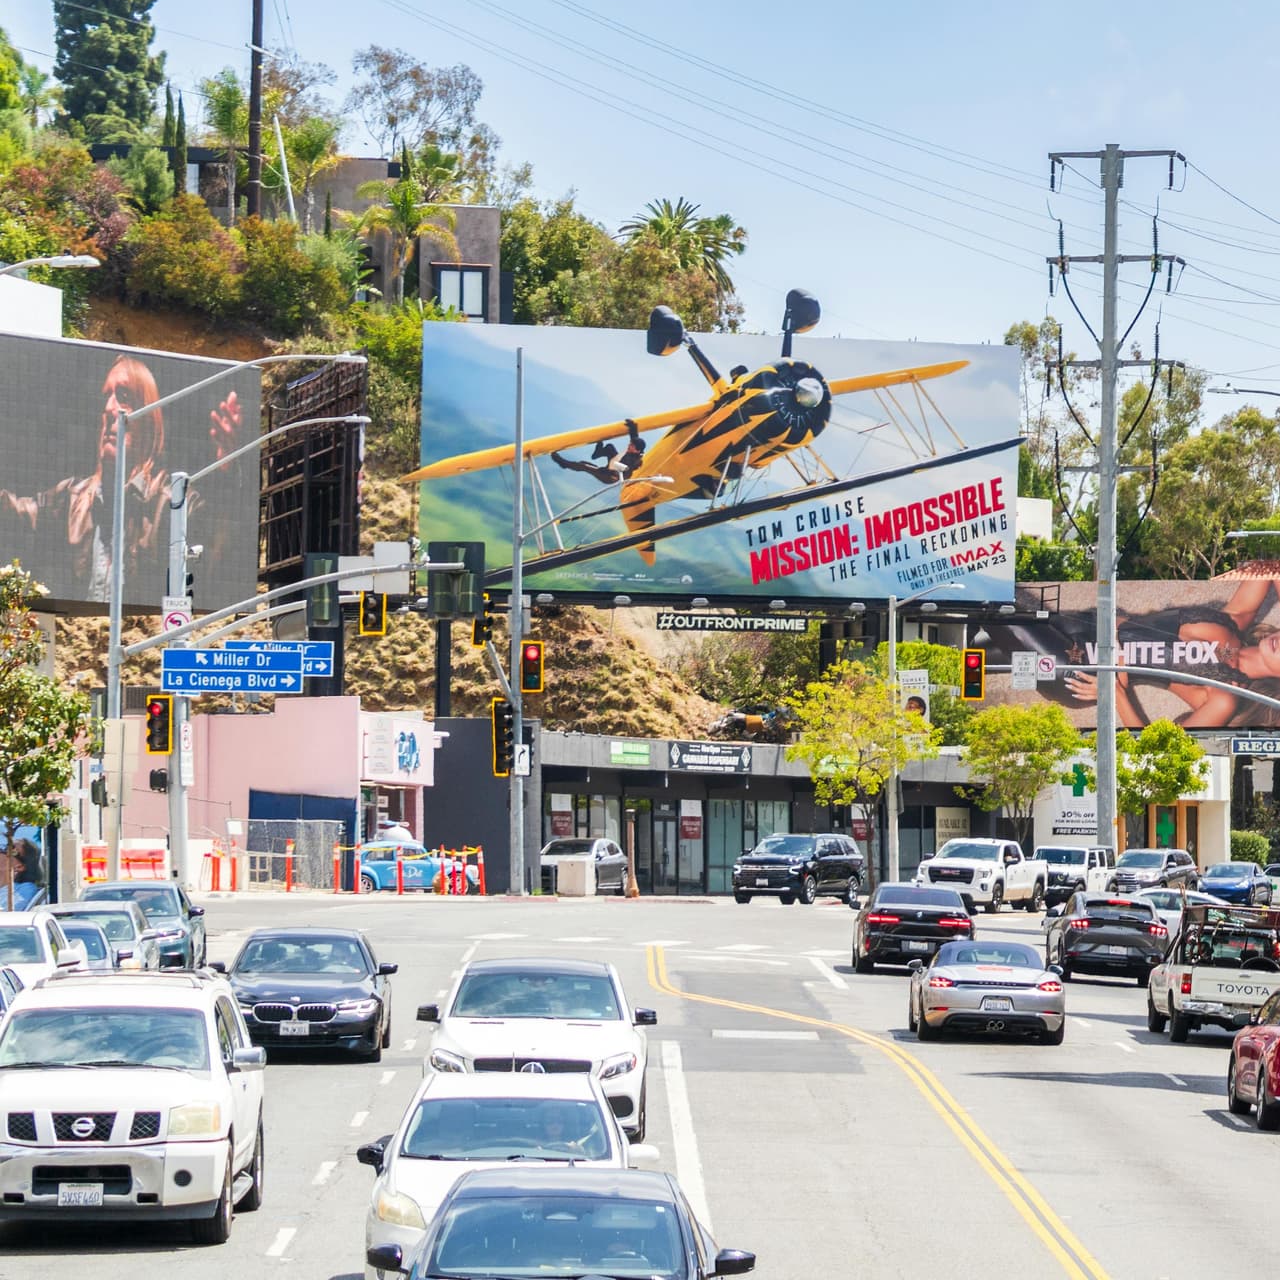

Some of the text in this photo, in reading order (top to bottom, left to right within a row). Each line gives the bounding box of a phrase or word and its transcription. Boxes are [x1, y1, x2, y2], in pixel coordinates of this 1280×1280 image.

[746, 496, 866, 547] TOM CRUISE
[749, 476, 1006, 585] MISSION: IMPOSSIBLE
[829, 513, 1009, 583] THE FINAL RECKONING
[897, 541, 1006, 584] FILMED FOR IMAX
[967, 560, 989, 573] MAY
[992, 554, 1007, 567] 23
[657, 613, 806, 631] #OUTFRONTPRIME
[213, 654, 272, 667] Miller Dr
[1172, 641, 1220, 665] FOX
[167, 673, 277, 690] La Cienega Blvd
[1217, 983, 1270, 996] TOYOTA
